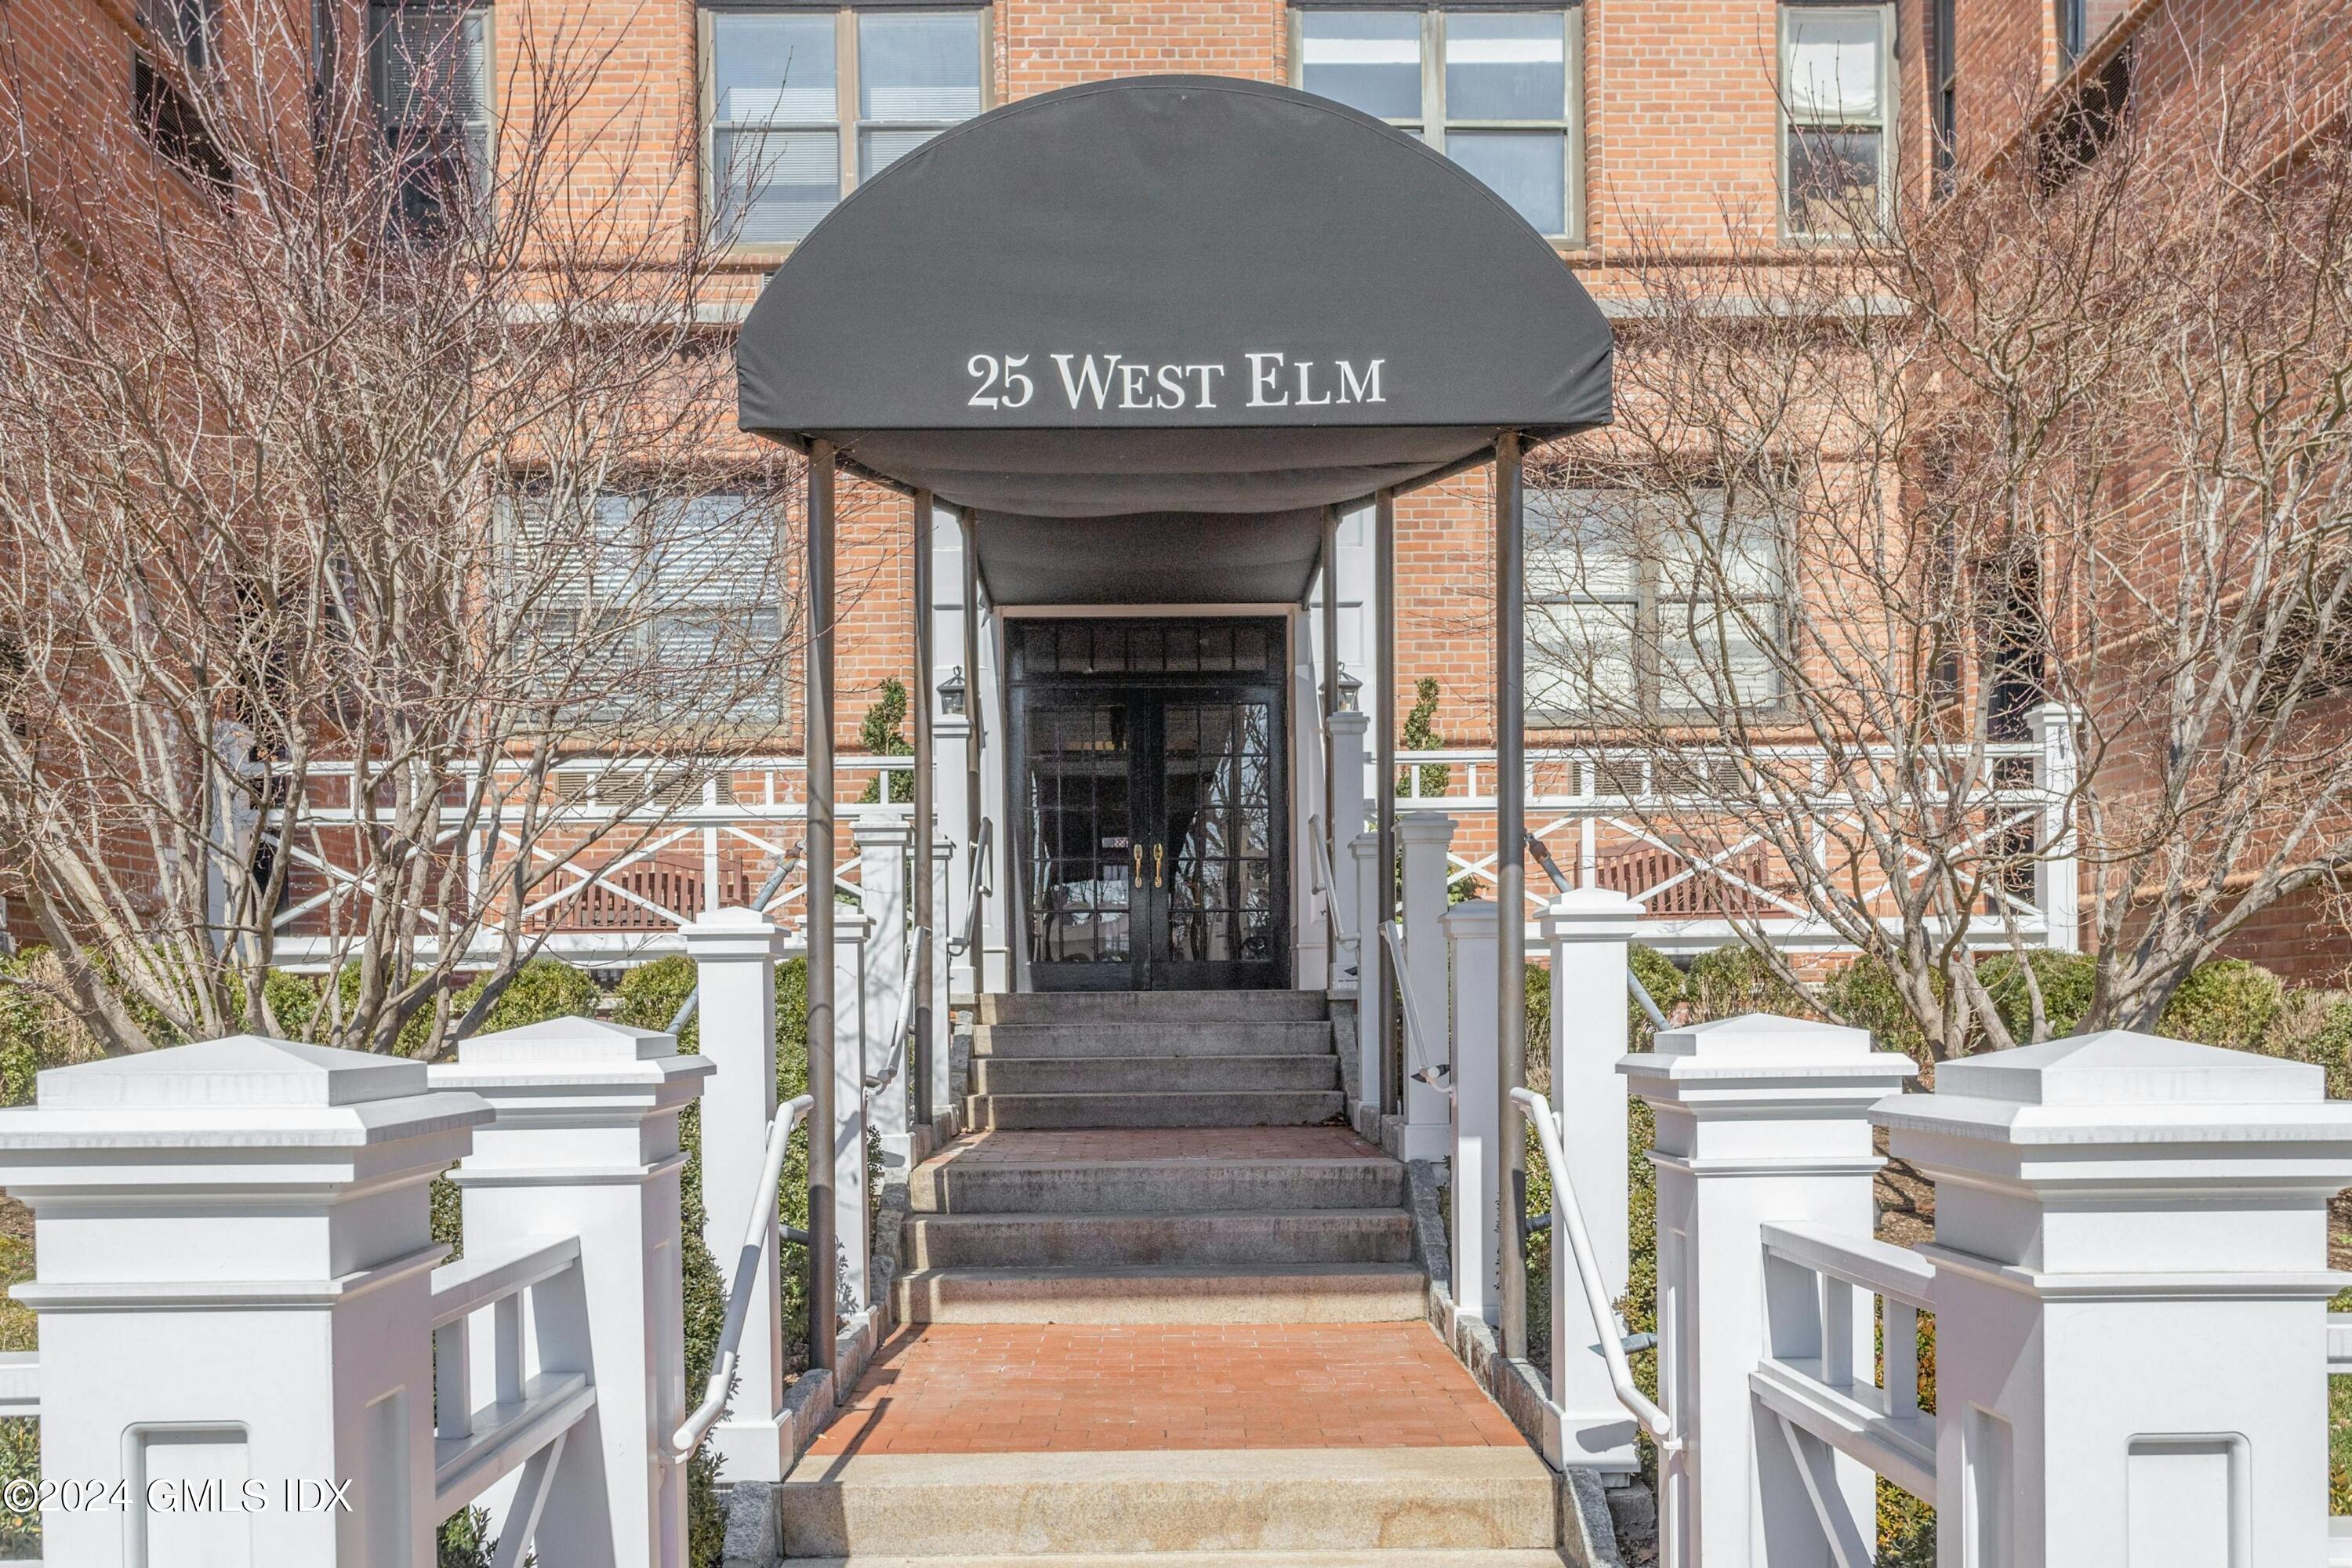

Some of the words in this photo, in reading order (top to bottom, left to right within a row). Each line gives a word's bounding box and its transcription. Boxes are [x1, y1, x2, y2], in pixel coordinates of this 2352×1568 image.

[967, 353, 1034, 410] 25
[1050, 354, 1225, 410] WEST
[1245, 352, 1387, 407] ELM
